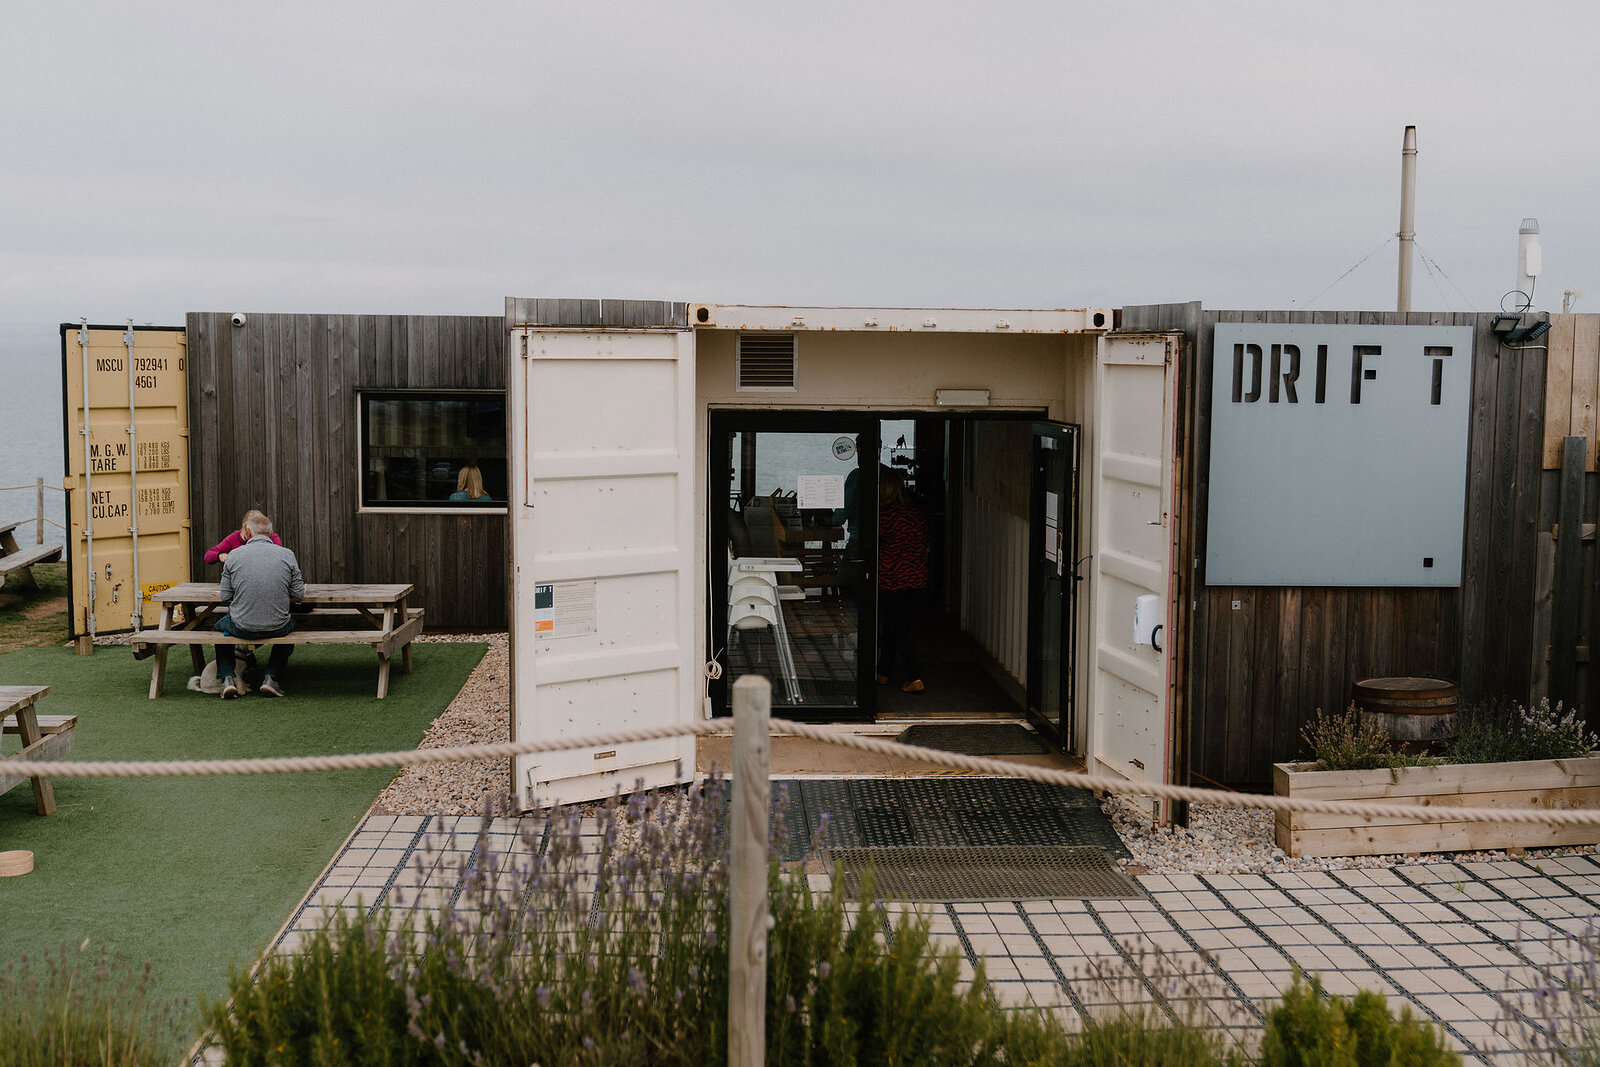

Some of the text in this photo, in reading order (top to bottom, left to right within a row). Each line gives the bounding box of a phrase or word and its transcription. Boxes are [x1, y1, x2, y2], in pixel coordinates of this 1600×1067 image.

[96, 358, 123, 372] MSCU
[135, 358, 168, 371] 792941
[135, 375, 157, 388] 45G1
[1231, 343, 1453, 405] DRIFT
[91, 457, 117, 472] TARE
[91, 490, 111, 505] NET
[92, 503, 129, 519] CU.CAP.
[148, 584, 170, 592] CAUTION
